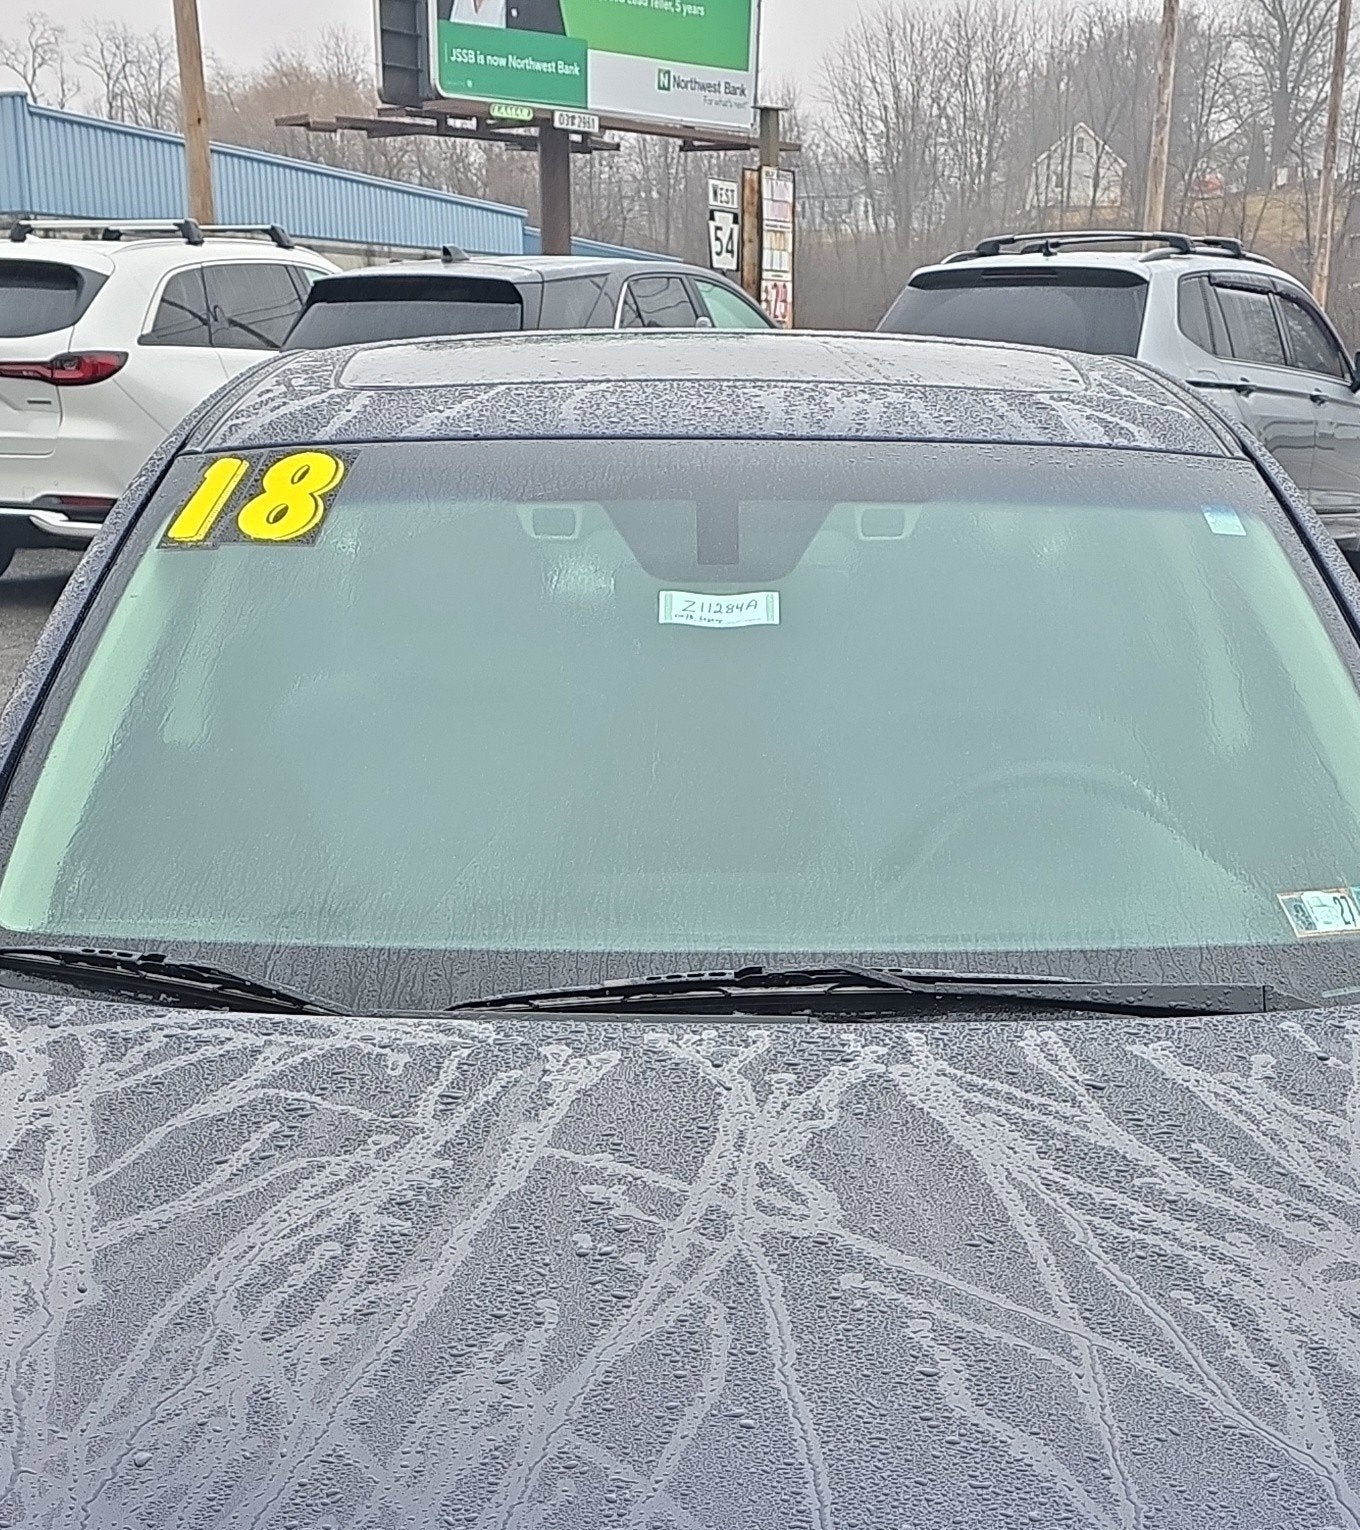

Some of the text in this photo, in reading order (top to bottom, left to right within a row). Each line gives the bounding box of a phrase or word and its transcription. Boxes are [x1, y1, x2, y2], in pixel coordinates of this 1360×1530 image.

[675, 0, 681, 12] 5
[681, 3, 705, 17] years
[450, 48, 580, 76] JSSB is now Northwest Bank
[672, 74, 721, 94] Northwest
[724, 81, 747, 97] Bank
[712, 184, 735, 206] WEST
[714, 225, 735, 258] 54
[167, 451, 345, 542] 18
